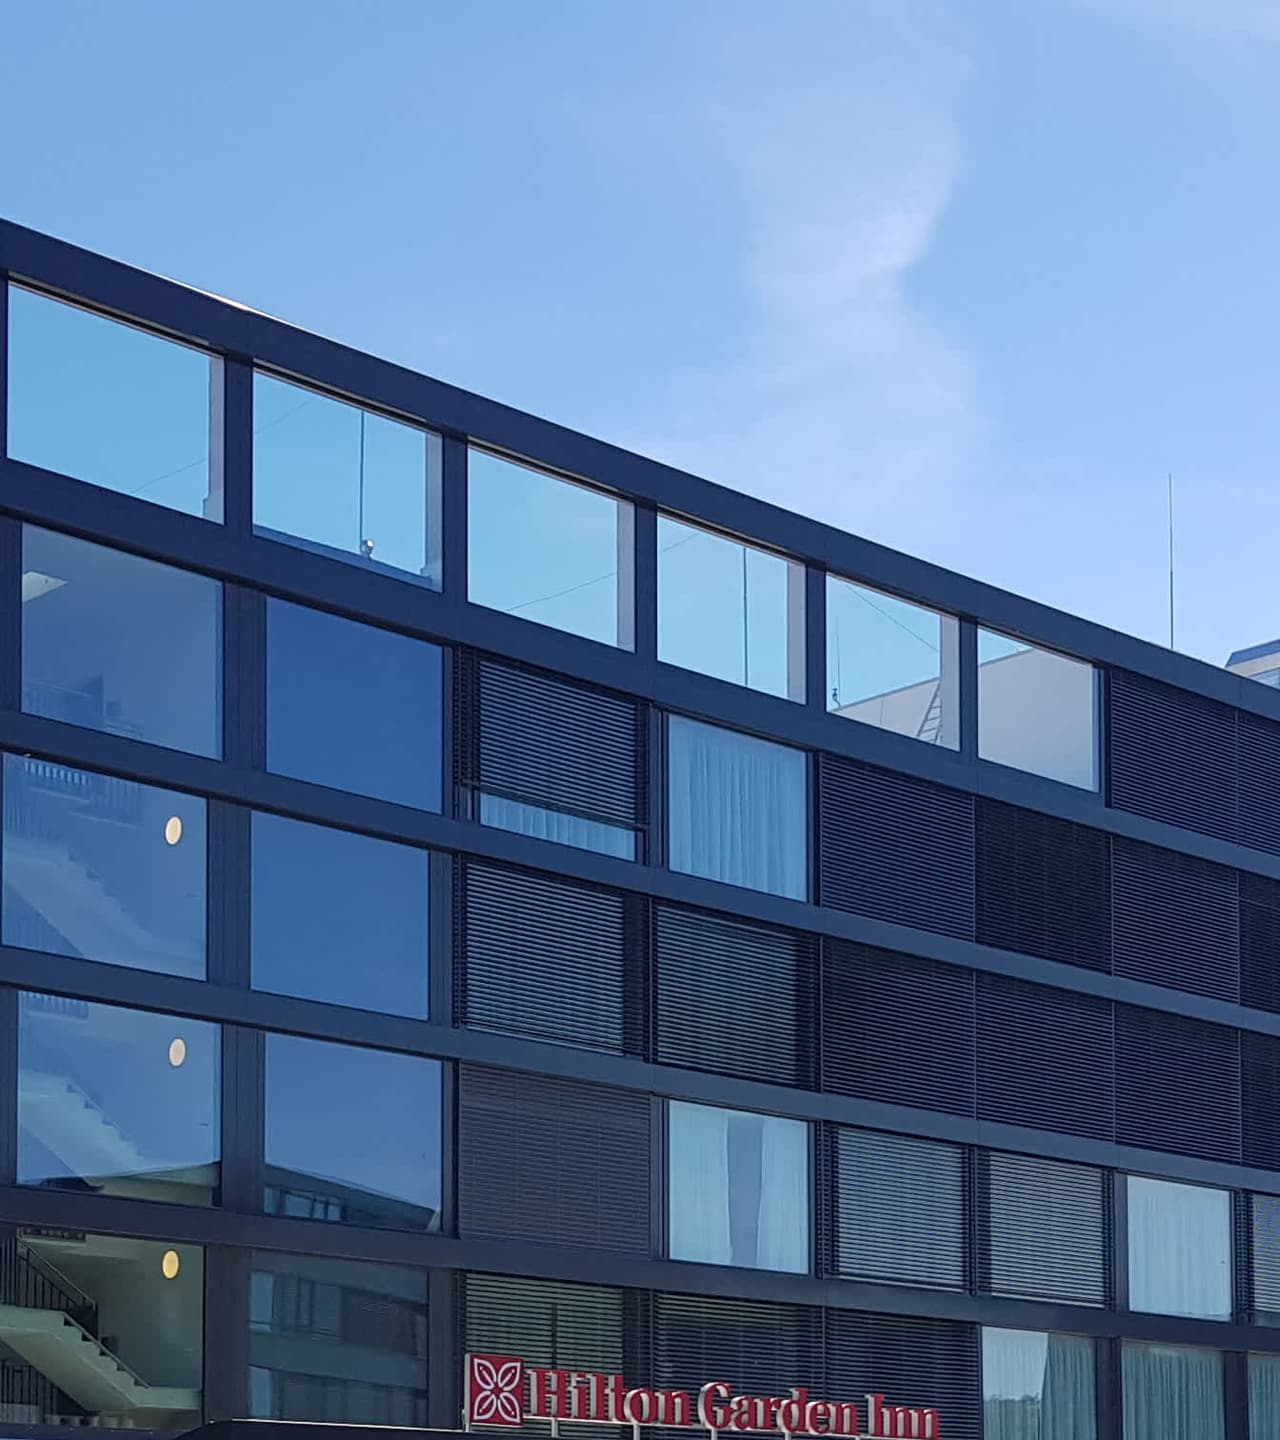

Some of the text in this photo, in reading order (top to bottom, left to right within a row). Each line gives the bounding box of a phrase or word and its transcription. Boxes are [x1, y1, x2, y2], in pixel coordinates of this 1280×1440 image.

[528, 1368, 941, 1440] Hilton Garden Inn
